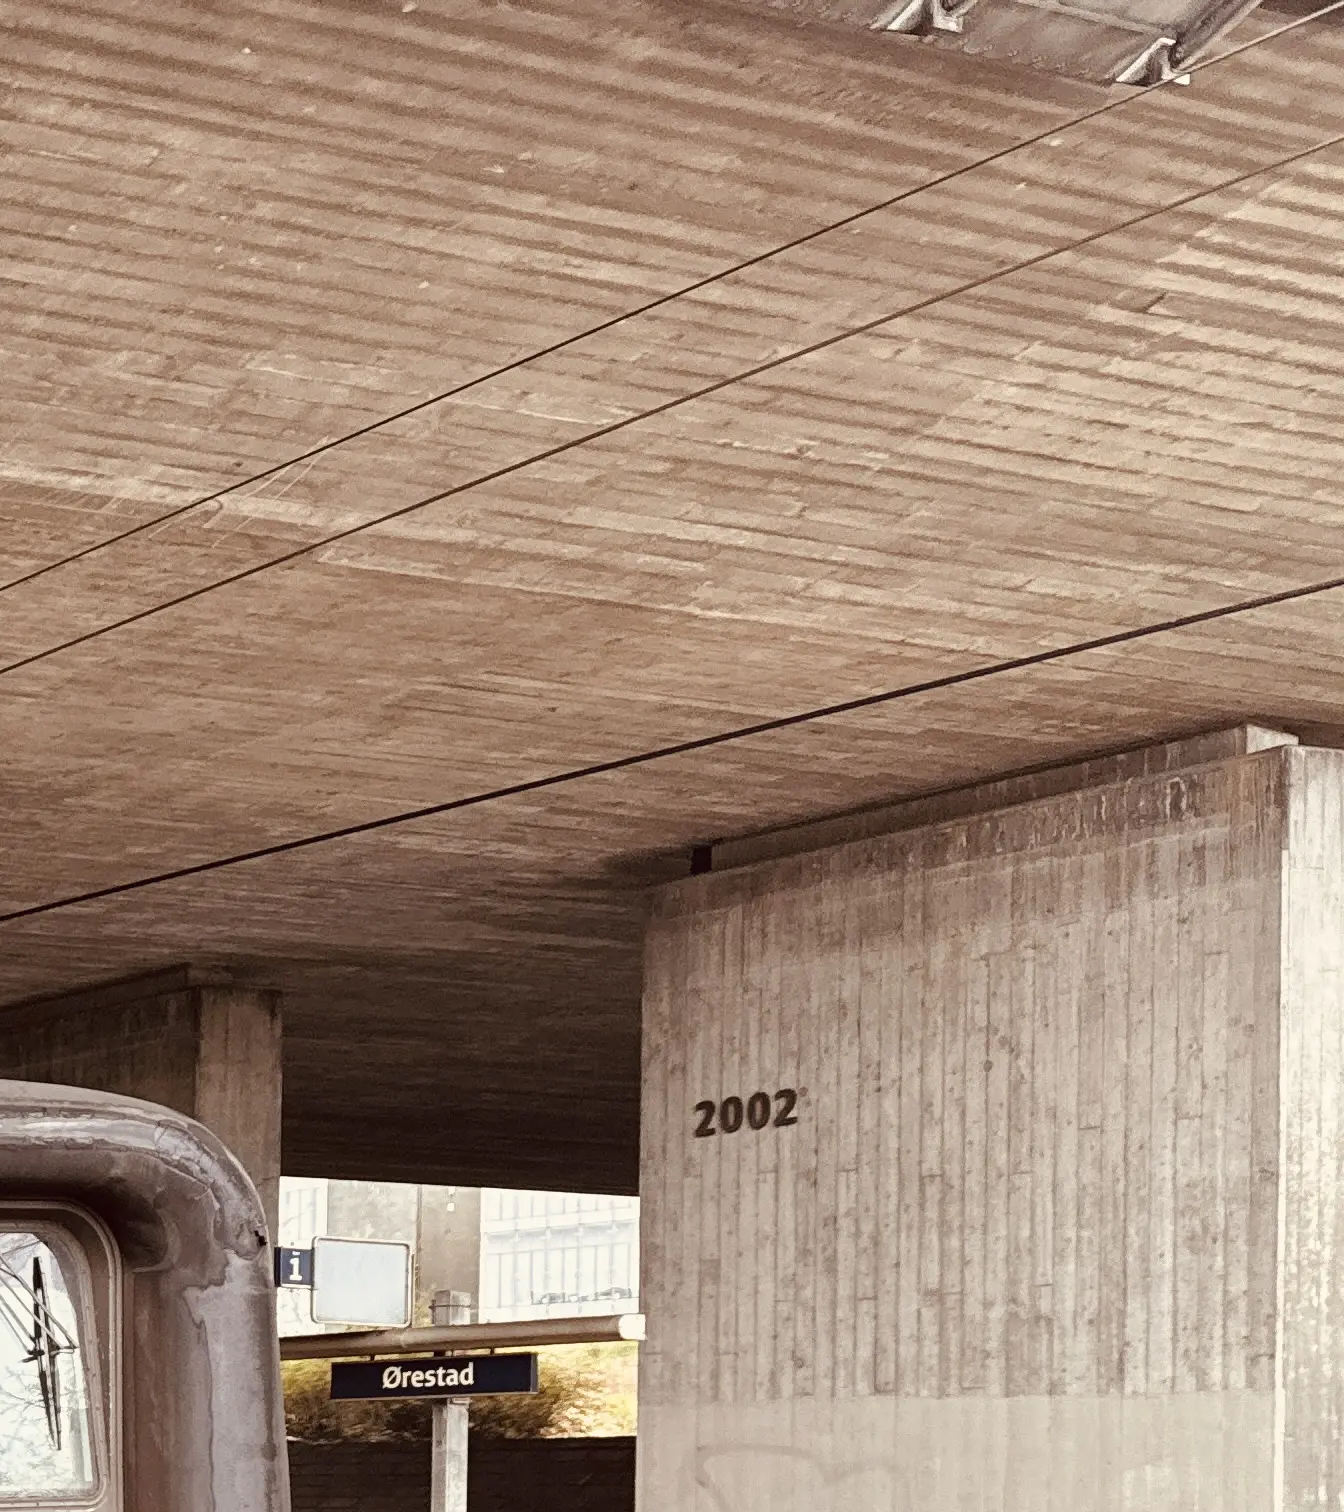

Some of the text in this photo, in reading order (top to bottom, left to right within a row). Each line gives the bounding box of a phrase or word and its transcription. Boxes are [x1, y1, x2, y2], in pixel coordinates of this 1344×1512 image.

[694, 1088, 799, 1139] 2002
[289, 1257, 303, 1281] 1
[381, 1361, 475, 1390] Ørestad
